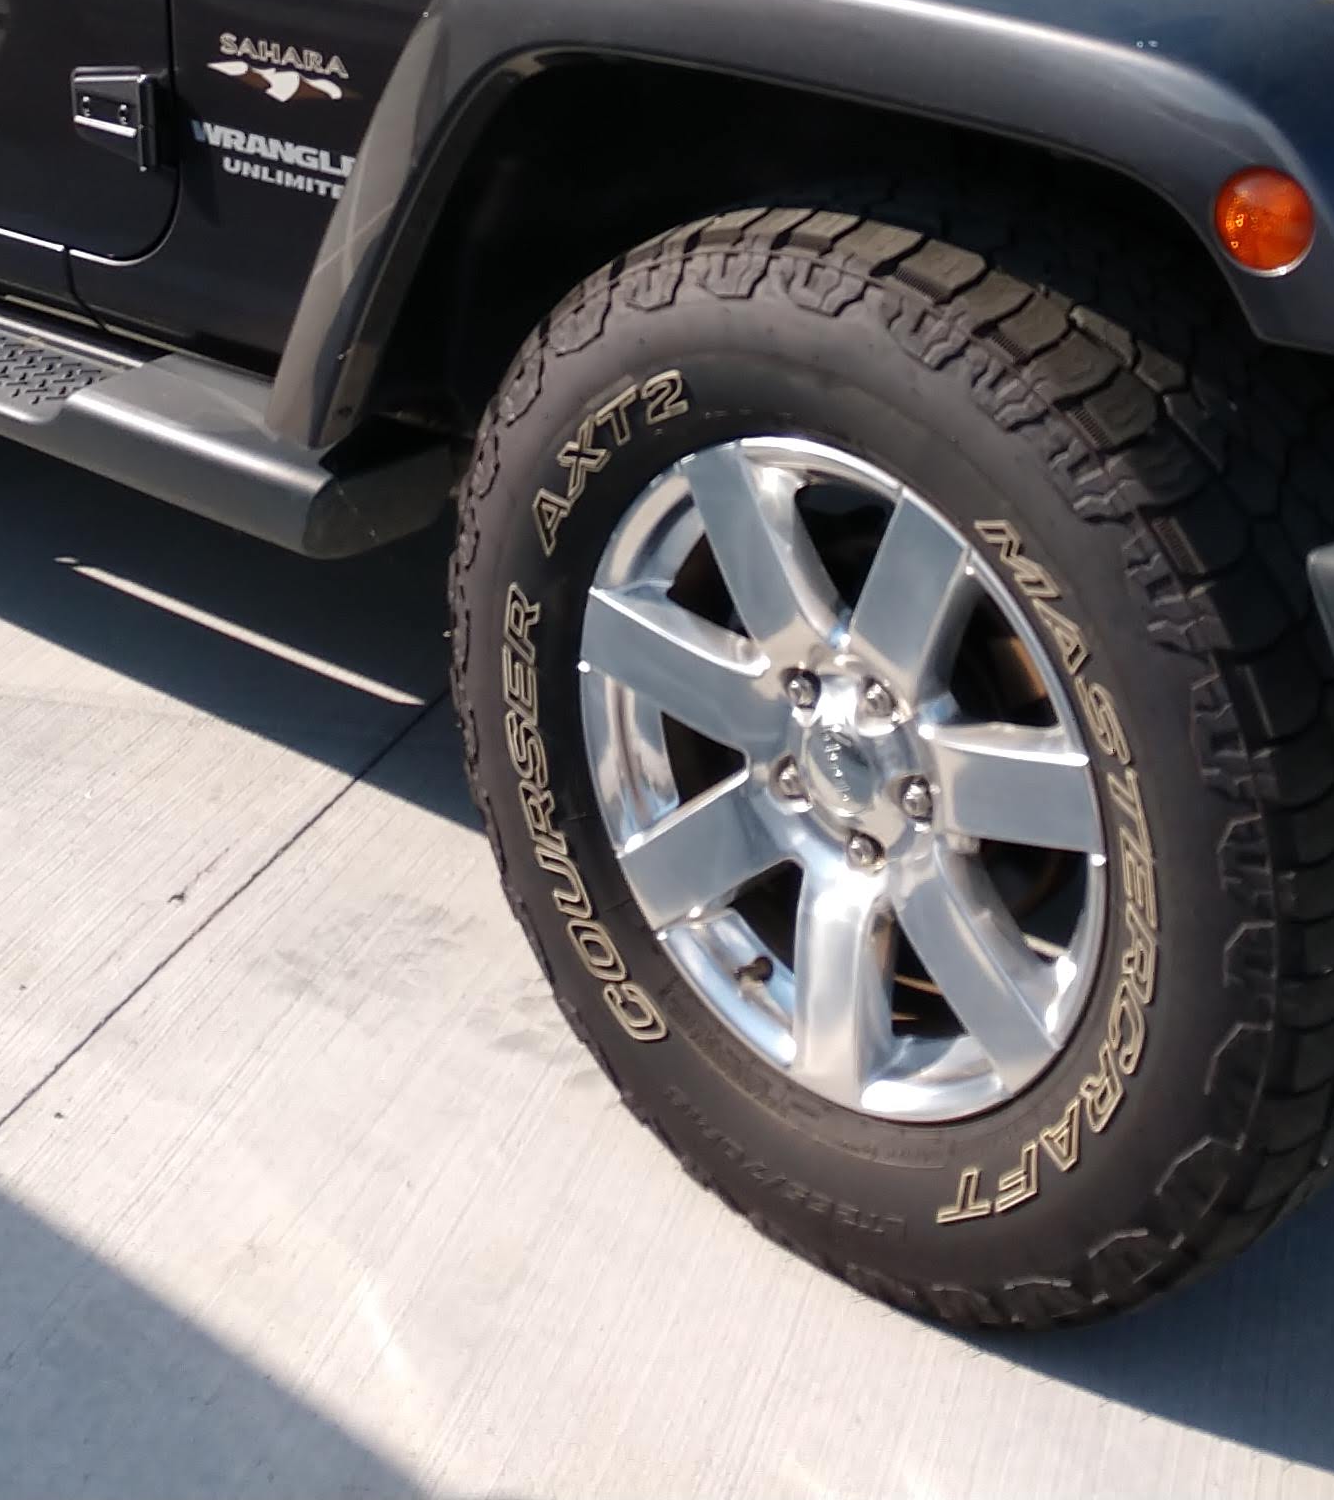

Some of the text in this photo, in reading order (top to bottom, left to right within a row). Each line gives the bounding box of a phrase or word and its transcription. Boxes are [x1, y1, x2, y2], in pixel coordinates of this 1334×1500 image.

[219, 31, 351, 80] SAHARA
[190, 119, 358, 178] WRANGLE
[222, 156, 346, 201] UNLIMITE
[532, 369, 690, 558] AXT2
[500, 581, 670, 1043] COURSER
[936, 518, 1161, 1226] MASTERCRAFT
